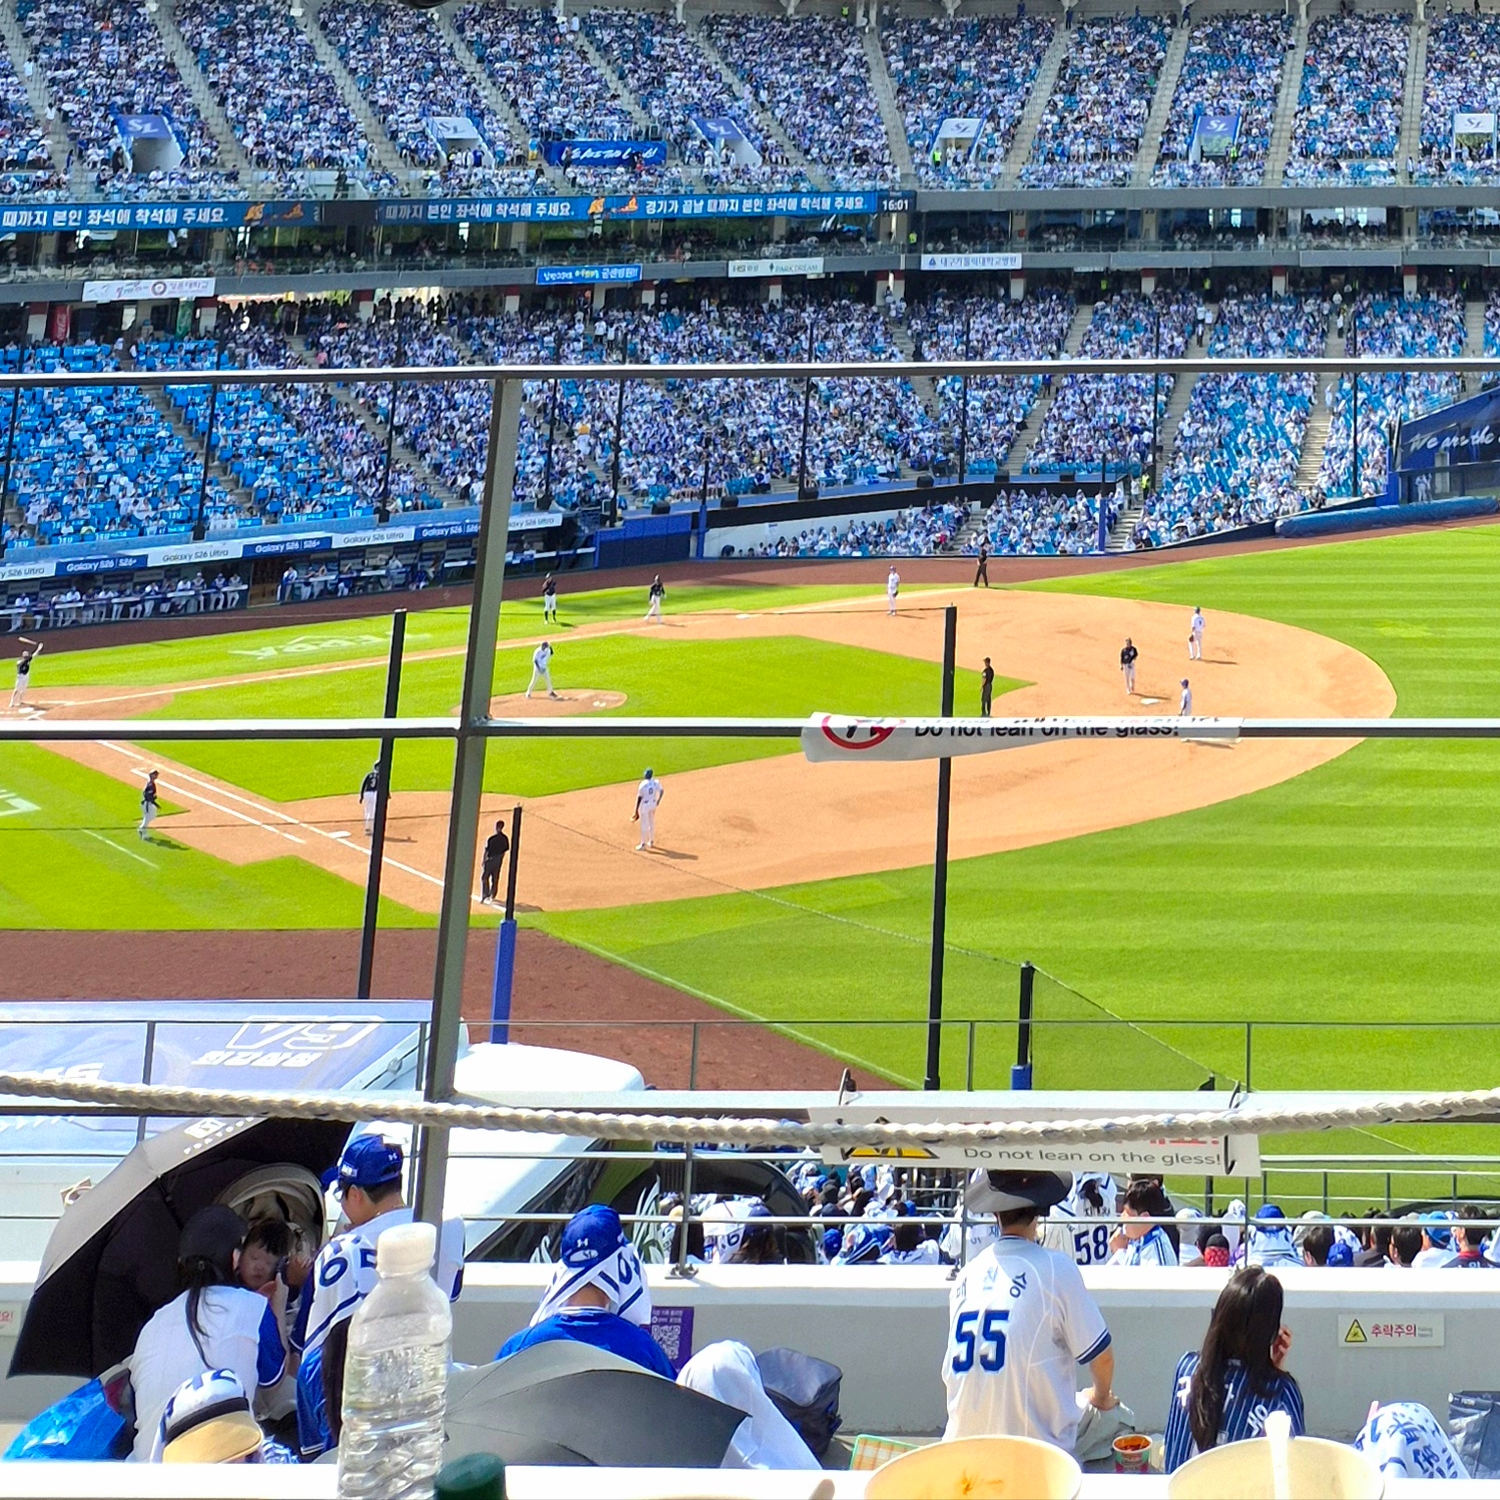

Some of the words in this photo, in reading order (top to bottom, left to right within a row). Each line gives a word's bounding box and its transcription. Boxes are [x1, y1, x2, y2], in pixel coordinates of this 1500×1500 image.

[385, 206, 423, 220] 때까지
[426, 204, 452, 220] 본인
[455, 203, 492, 219] 좌석에
[496, 202, 532, 218] 착석해
[535, 202, 575, 217] 주세요.
[645, 199, 679, 215] 경기가
[706, 198, 739, 213] 때까지
[742, 197, 763, 213] 본인
[766, 197, 798, 212] 좌석에
[800, 196, 831, 211] 착석해
[882, 199, 909, 211] 16:01
[2, 210, 48, 228] 때까지
[52, 209, 83, 227] 본인
[87, 208, 131, 227] 좌석에
[135, 207, 178, 225] 착석해
[182, 206, 229, 224] 주세요.
[1409, 432, 1439, 452] We
[1470, 426, 1497, 447] the
[343, 534, 371, 545] Galaxy
[386, 531, 404, 541] Ultra
[422, 527, 450, 538] Galaxy
[255, 543, 285, 554] Galaxy
[162, 552, 194, 564] Galaxy
[195, 550, 208, 560] S26
[209, 549, 229, 560] Ultra
[22, 566, 45, 577] Ultra
[66, 561, 100, 573] Galaxy
[963, 1147, 992, 1160] Do
[998, 1148, 1034, 1161] not
[1039, 1148, 1083, 1162] lean
[1088, 1151, 1116, 1164] on
[1121, 1150, 1156, 1164] the
[1074, 1225, 1108, 1266] 58
[1371, 1323, 1417, 1338] 추락주의
[951, 1309, 1010, 1373] 55
